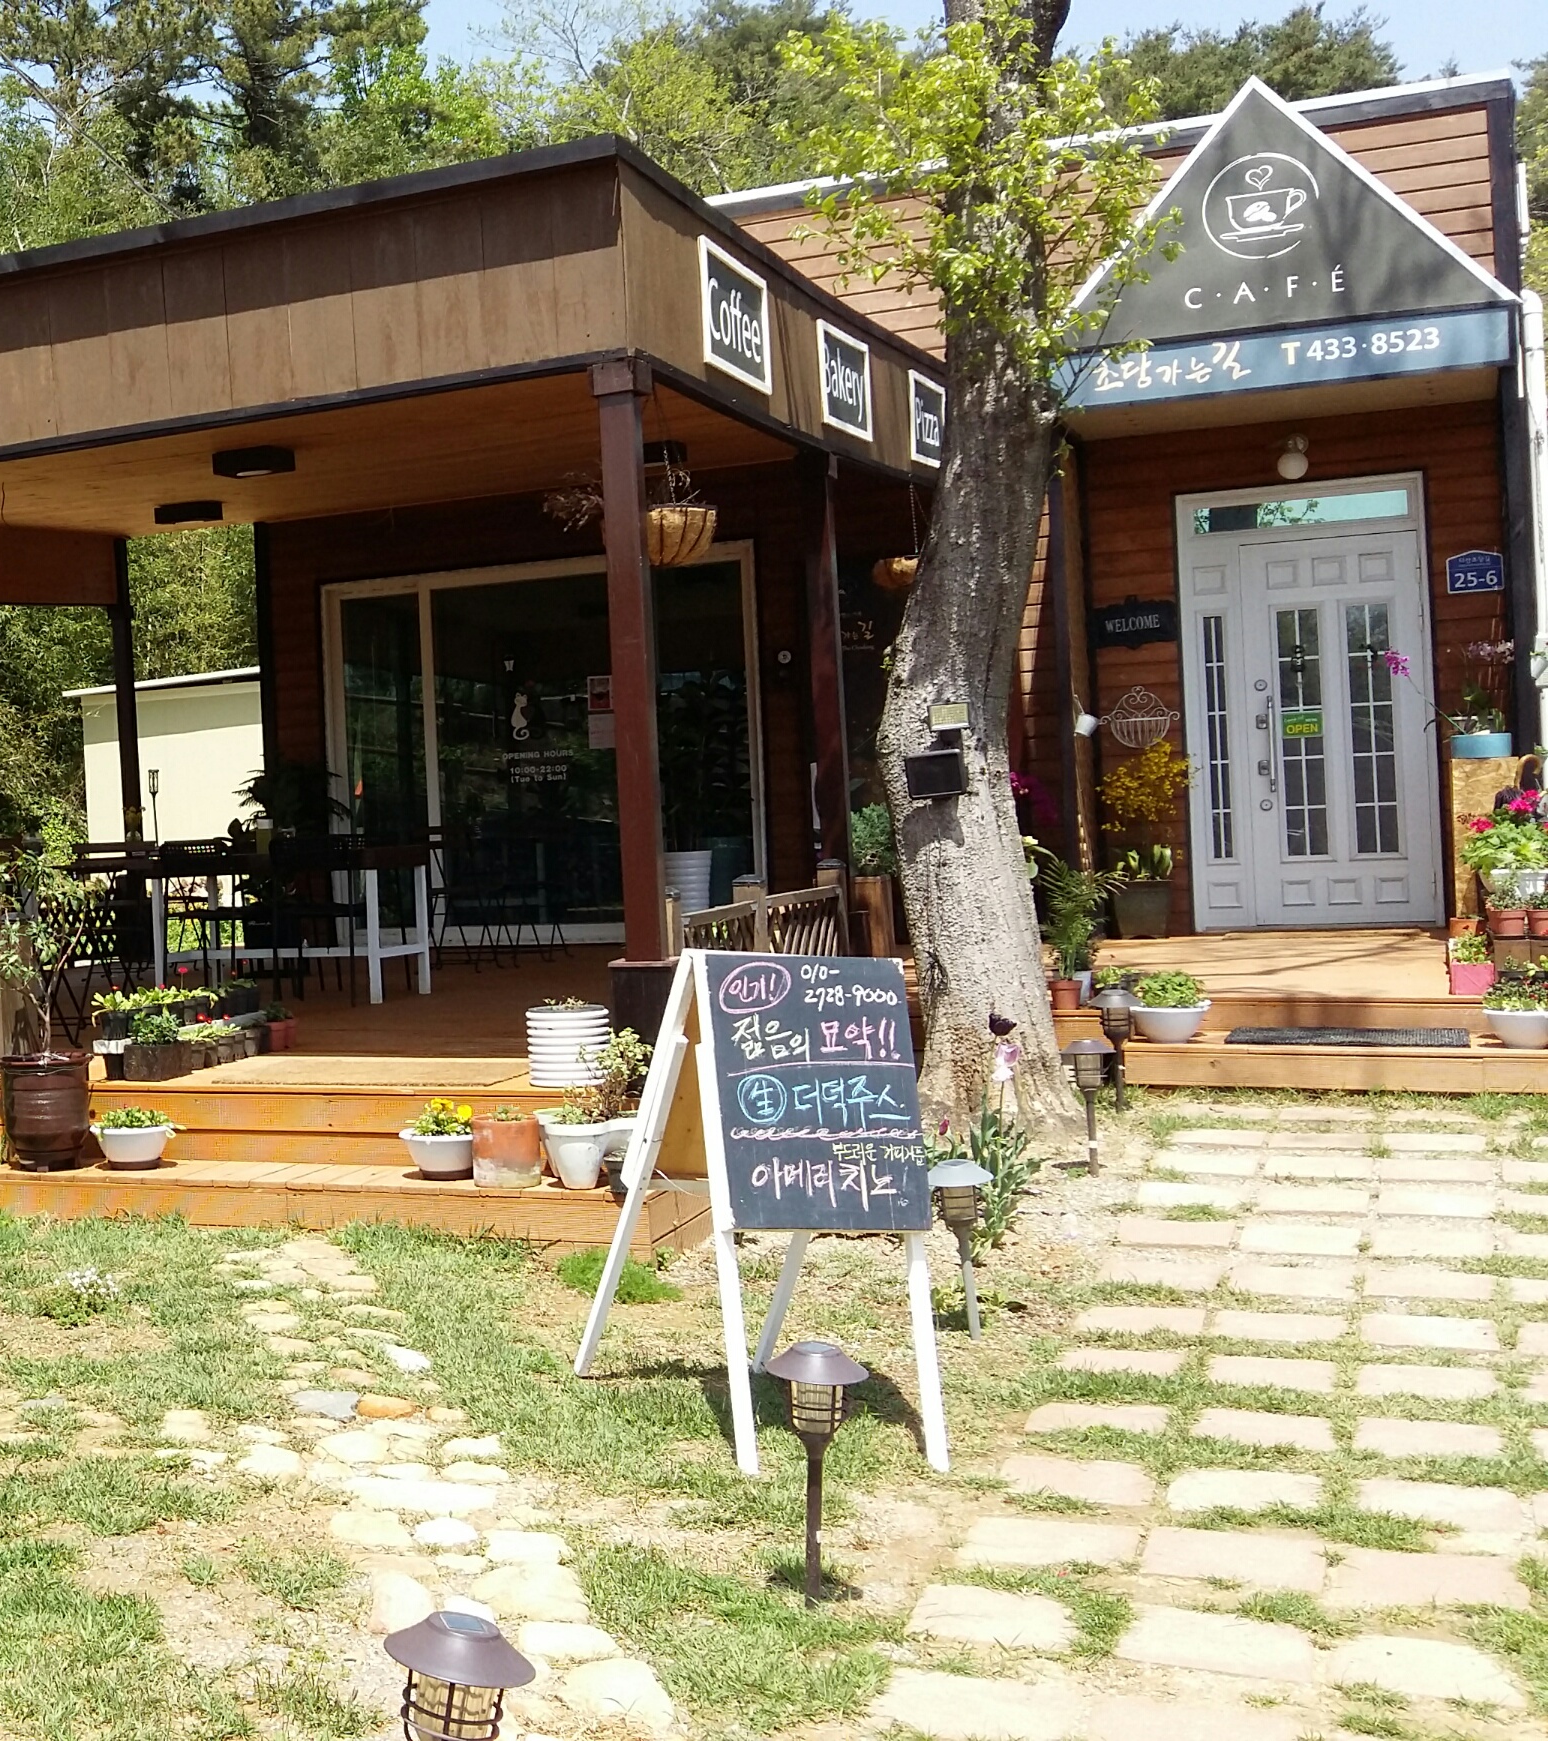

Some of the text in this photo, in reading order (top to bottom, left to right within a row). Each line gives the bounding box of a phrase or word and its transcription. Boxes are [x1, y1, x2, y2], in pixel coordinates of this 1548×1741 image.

[708, 277, 761, 363] Coffee
[823, 343, 864, 422] Bakery
[915, 397, 940, 447] Pizza
[1454, 570, 1498, 588] 25-6
[1105, 614, 1161, 633] WELCOME
[1286, 723, 1319, 735] OPEN
[502, 748, 574, 760] OPENING HOURS
[510, 764, 568, 775] 10:00-22:00
[804, 984, 898, 1012] 2728-9000
[832, 1142, 877, 1166] 부드러운
[751, 1156, 898, 1212] 아메리치노
